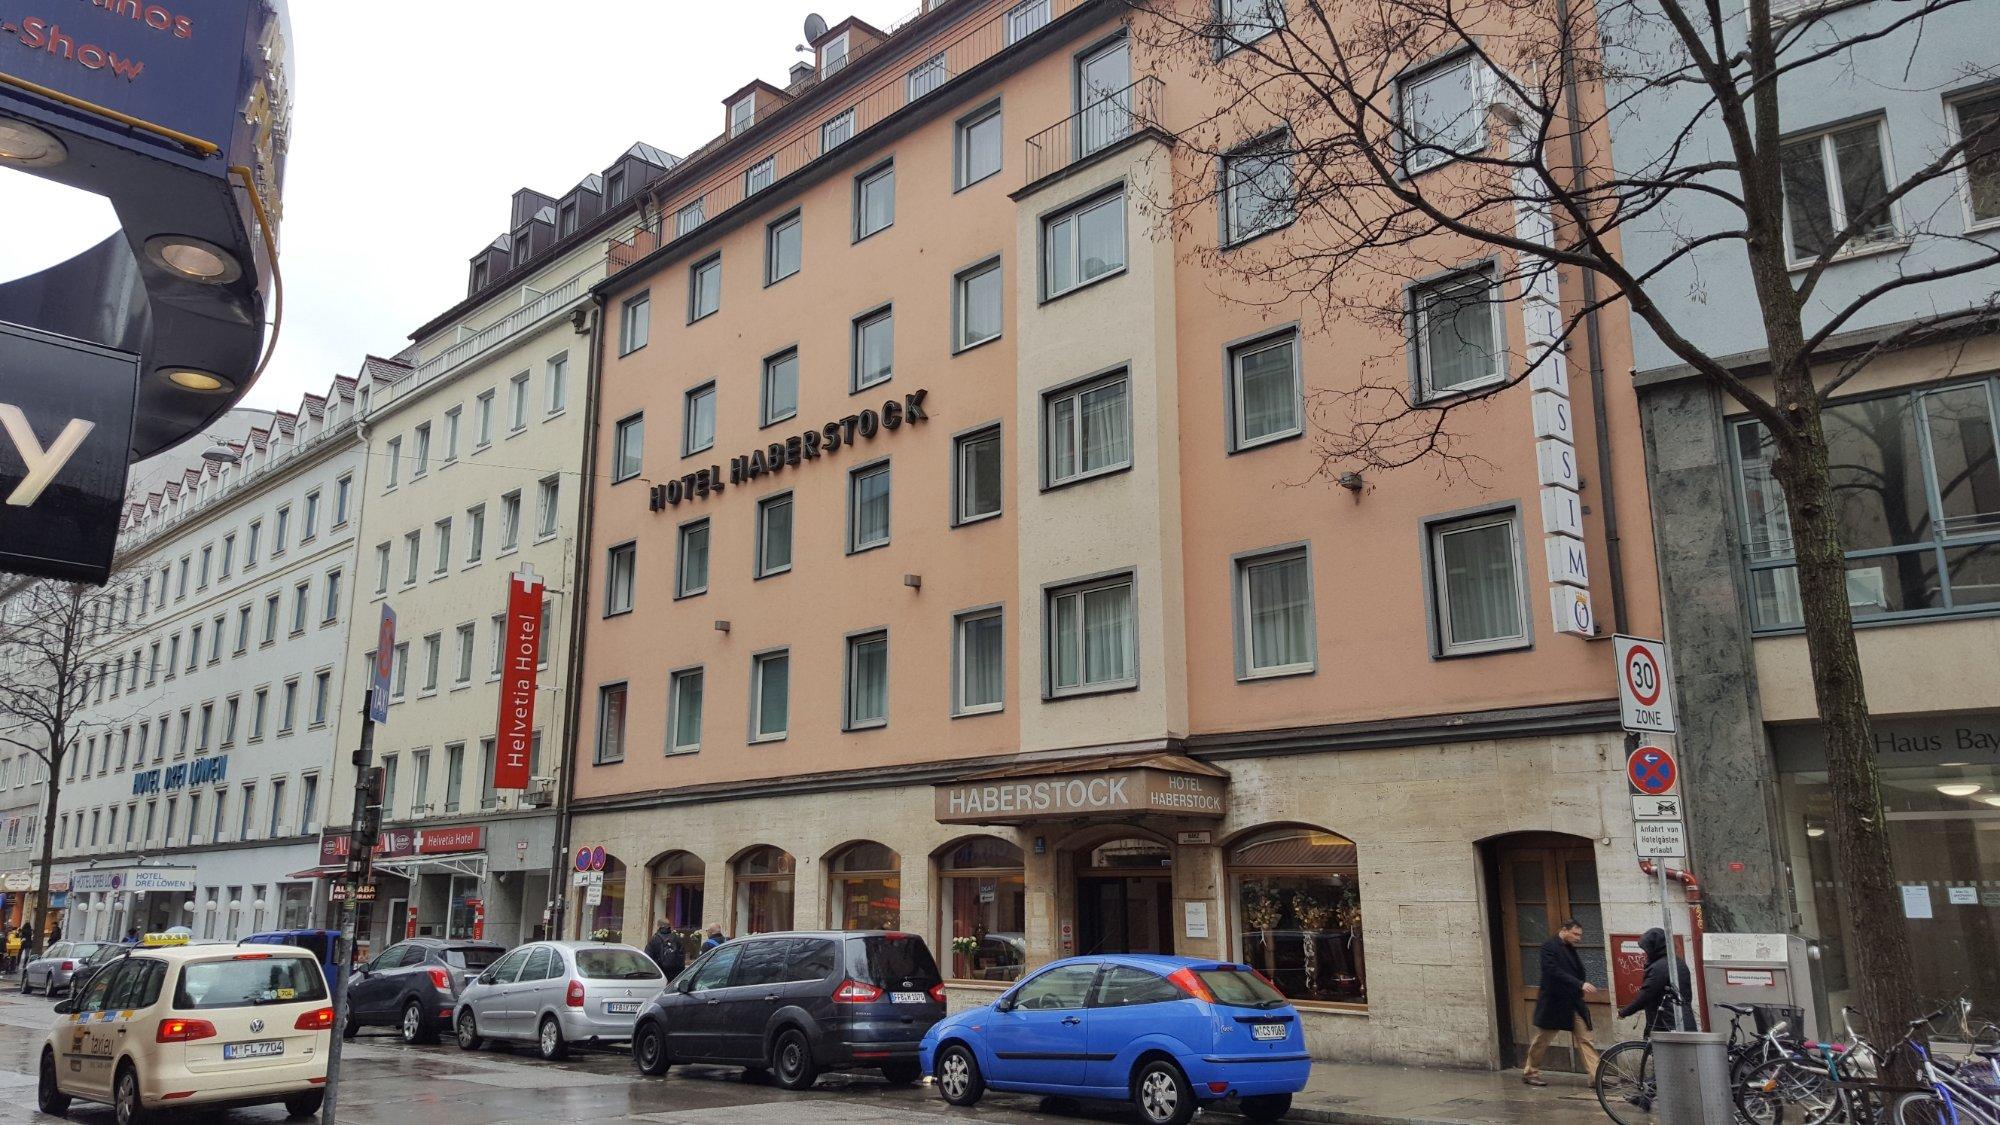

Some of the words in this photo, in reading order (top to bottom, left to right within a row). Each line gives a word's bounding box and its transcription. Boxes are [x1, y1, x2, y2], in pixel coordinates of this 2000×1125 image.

[649, 464, 725, 512] HOTEL
[730, 388, 929, 486] HABERSTOCK
[515, 615, 535, 670] Hotel
[1632, 661, 1654, 689] 30
[507, 679, 530, 767] Helvetia
[1635, 709, 1662, 726] ZONE
[1875, 732, 1942, 753] Haus
[1168, 776, 1202, 792] HOTEL
[949, 776, 1129, 814] HABERSTOCK
[1151, 792, 1221, 810] HABERSTOCK
[1640, 825, 1664, 833] Anfahrt
[428, 834, 454, 846] Helvetia
[455, 832, 474, 844] Hotel
[1641, 835, 1679, 845] Hotelgästen
[1649, 846, 1673, 854] erlaubt
[136, 872, 163, 880] HOTEL
[156, 879, 186, 887] LÖWEN
[153, 932, 183, 941] TAXI
[231, 1045, 239, 1055] M
[244, 1044, 257, 1054] FL
[259, 1041, 283, 1053] 7704
